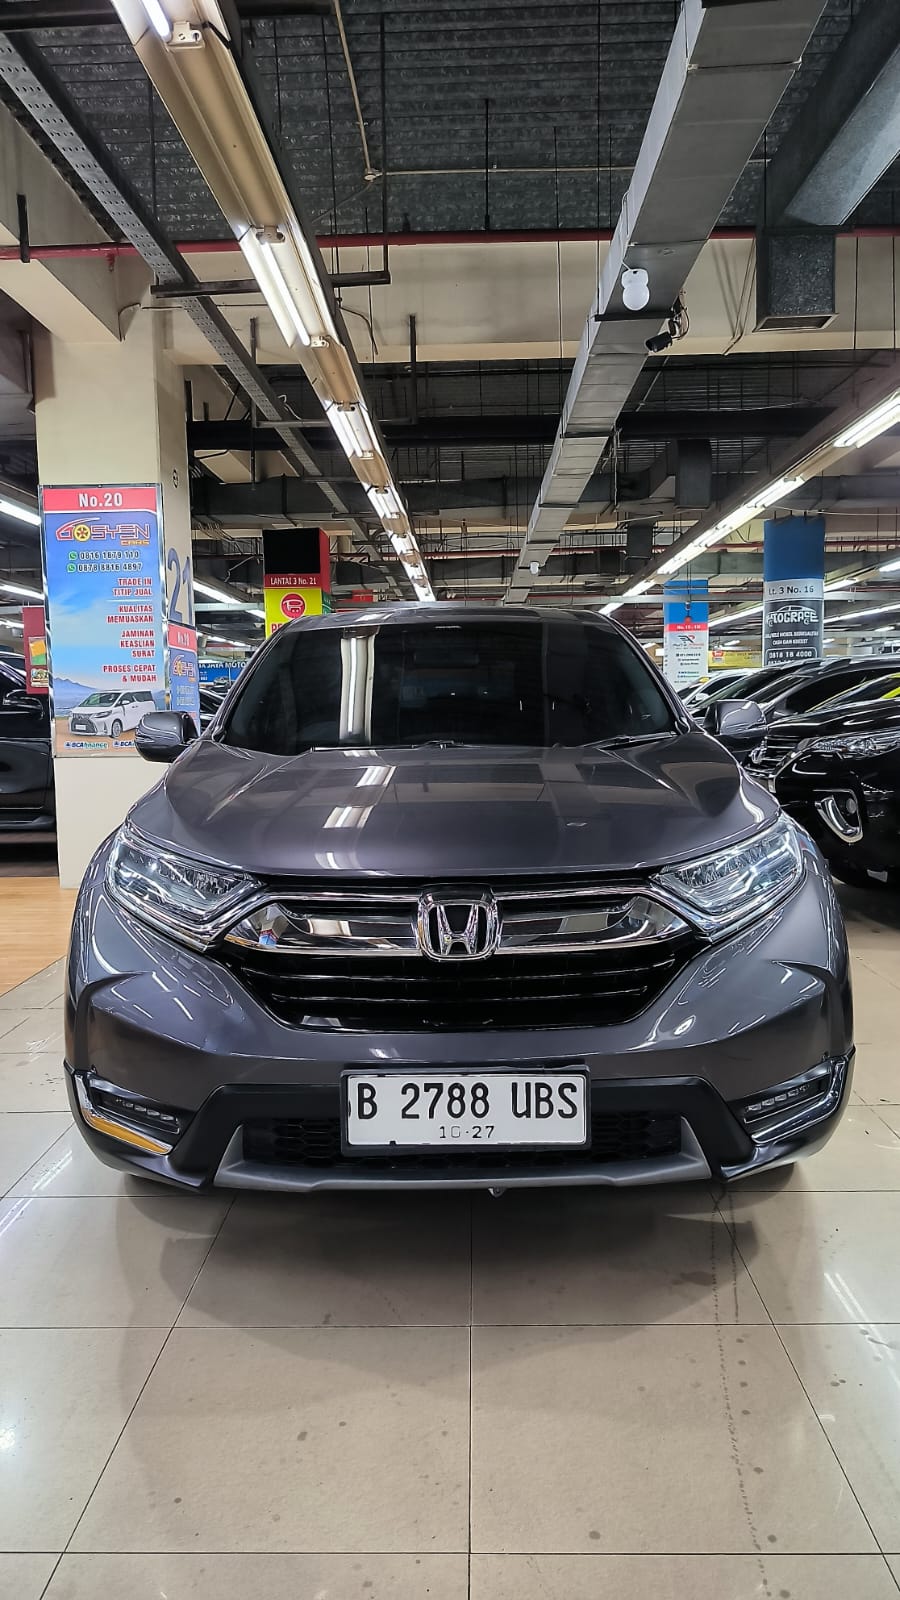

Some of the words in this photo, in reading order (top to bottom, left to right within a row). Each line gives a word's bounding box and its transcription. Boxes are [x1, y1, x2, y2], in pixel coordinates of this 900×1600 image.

[78, 492, 123, 507] No.20
[79, 551, 100, 560] 0816
[102, 551, 122, 560] 1879
[125, 550, 139, 559] 110
[78, 564, 98, 573] 0878
[100, 563, 120, 572] 8816
[123, 563, 143, 572] 4897
[118, 578, 141, 586] TRADE
[270, 577, 292, 585] LANTAI
[309, 577, 317, 585] 21
[113, 588, 131, 596] TITIP
[134, 588, 152, 596] JUAL
[779, 586, 784, 594] 3
[787, 585, 801, 594] No.
[804, 585, 814, 593] 16
[118, 605, 153, 613] KUALITAS
[107, 615, 154, 623] MEMUASKAN
[122, 630, 154, 638] JAMINAN
[120, 640, 155, 648] KEASLIAN
[132, 650, 155, 658] SURAT
[103, 665, 131, 673] PROSES
[134, 664, 156, 672] CEPAT
[130, 674, 157, 682] MUDAH
[357, 1082, 378, 1120] B
[401, 1082, 490, 1120] 2788
[511, 1081, 578, 1120] UBS
